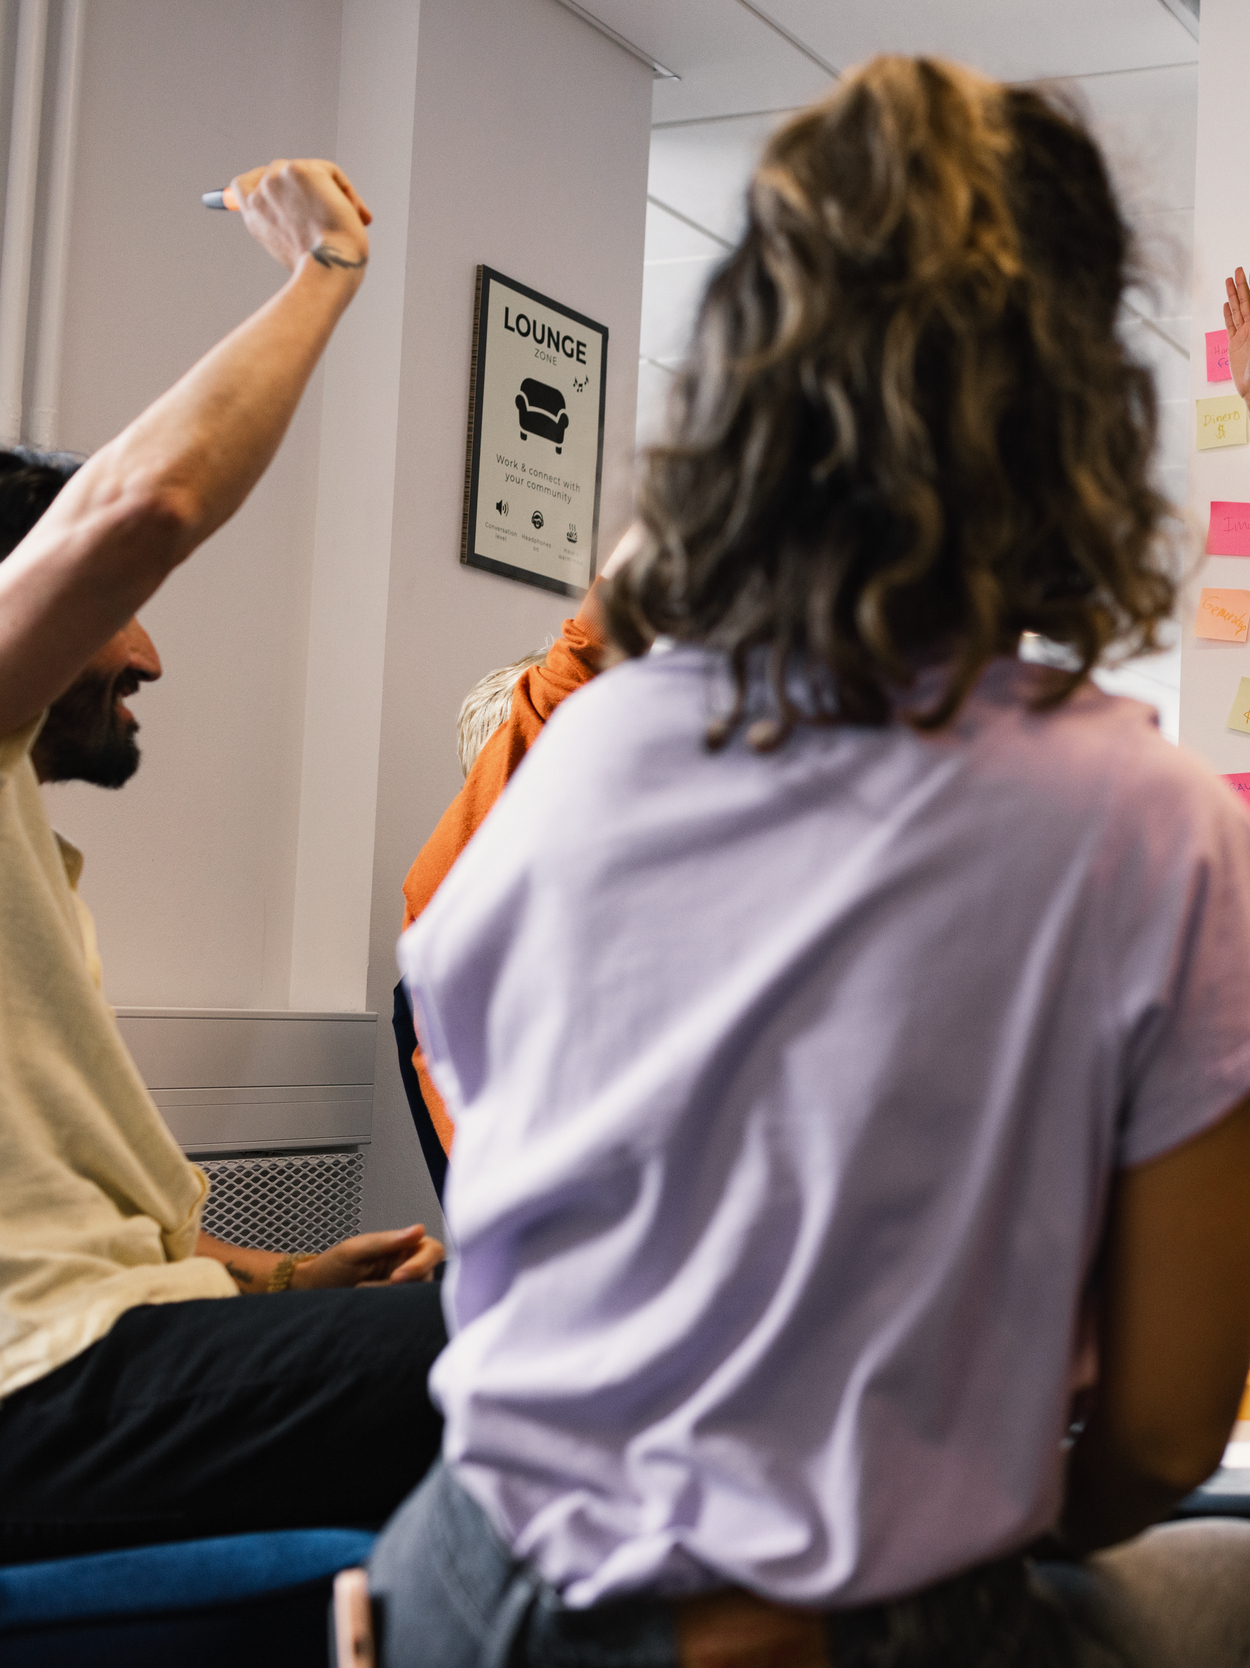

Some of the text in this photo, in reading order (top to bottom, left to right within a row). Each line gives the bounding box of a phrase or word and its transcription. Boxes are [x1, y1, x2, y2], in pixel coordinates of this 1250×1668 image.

[504, 306, 587, 365] LOUNGE
[534, 348, 558, 366] ZONE
[1204, 410, 1240, 427] Dinero
[496, 453, 581, 493] Work & connect with
[505, 472, 573, 505] your community
[485, 521, 518, 537] Conversation
[495, 533, 507, 542] level
[521, 534, 552, 549] Headphones
